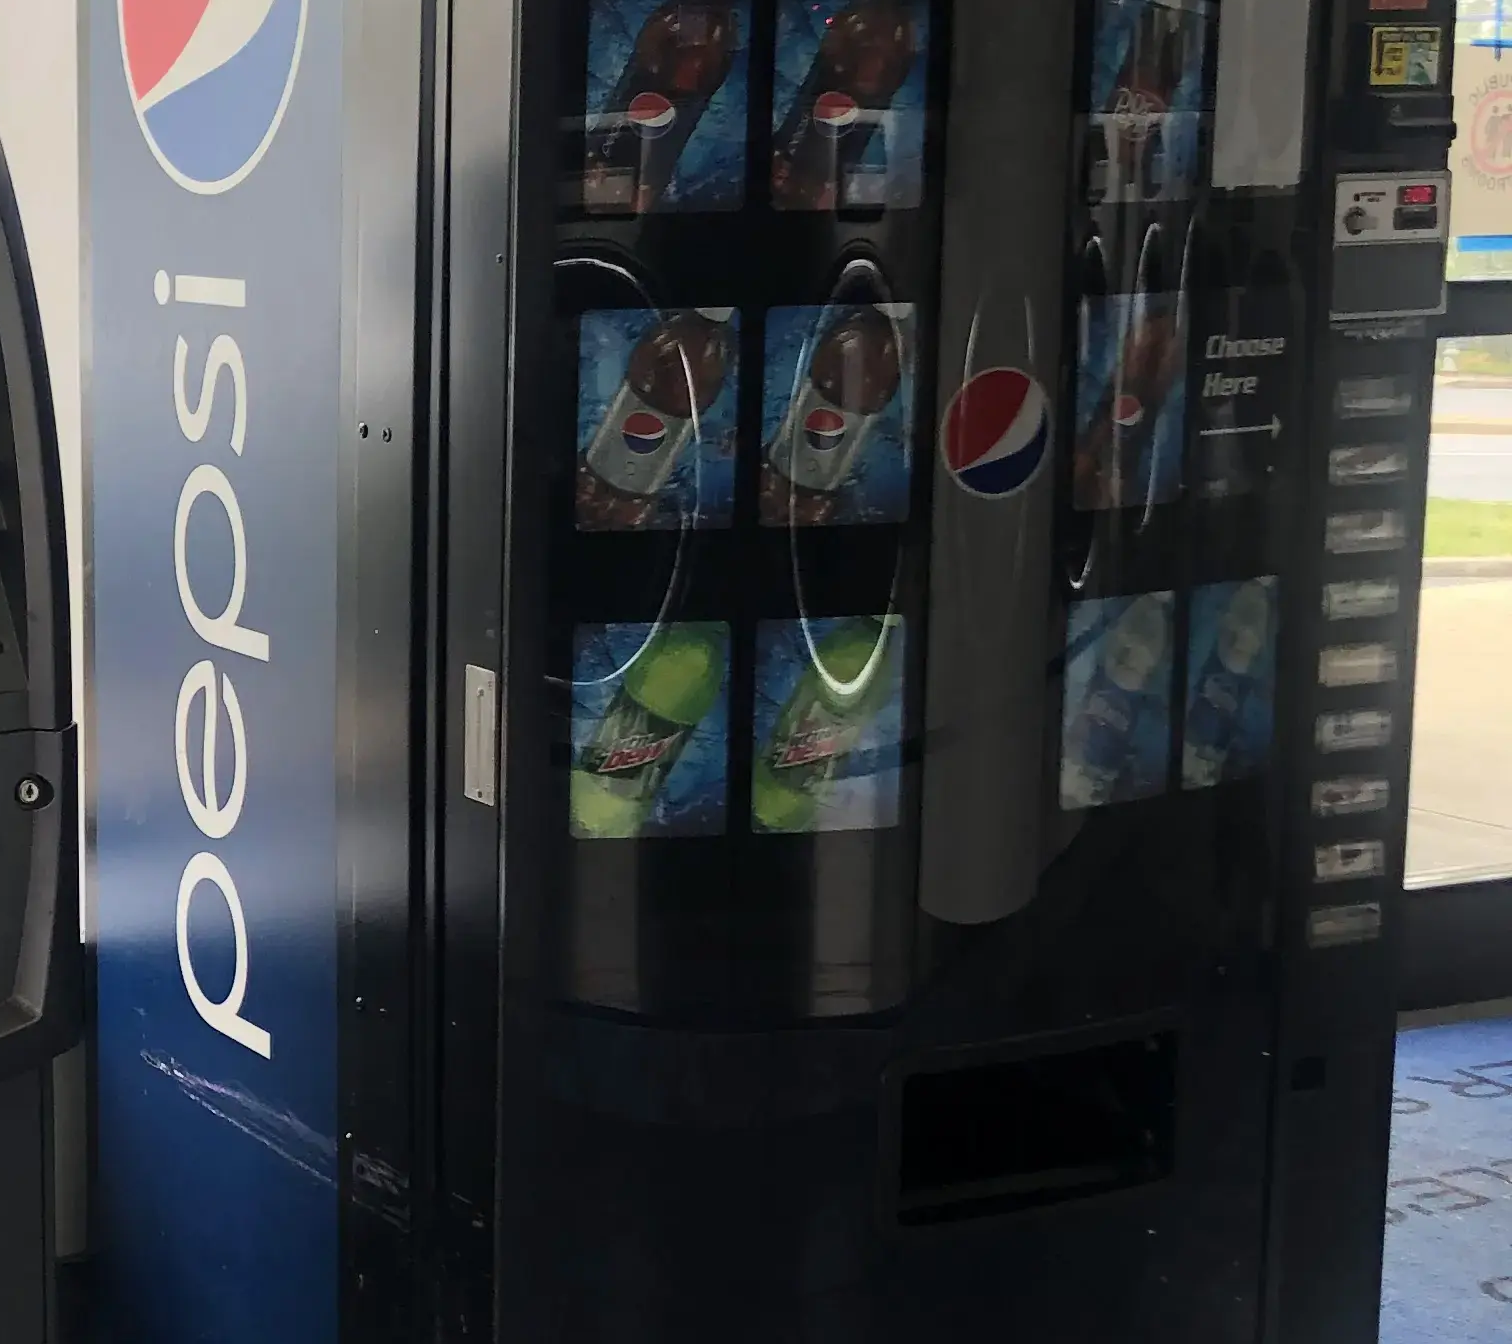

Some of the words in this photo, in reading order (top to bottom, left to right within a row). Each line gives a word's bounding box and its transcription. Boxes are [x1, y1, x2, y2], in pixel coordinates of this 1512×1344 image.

[1204, 334, 1286, 360] Choose
[1202, 372, 1258, 397] Here
[152, 268, 273, 1061] pepsi
